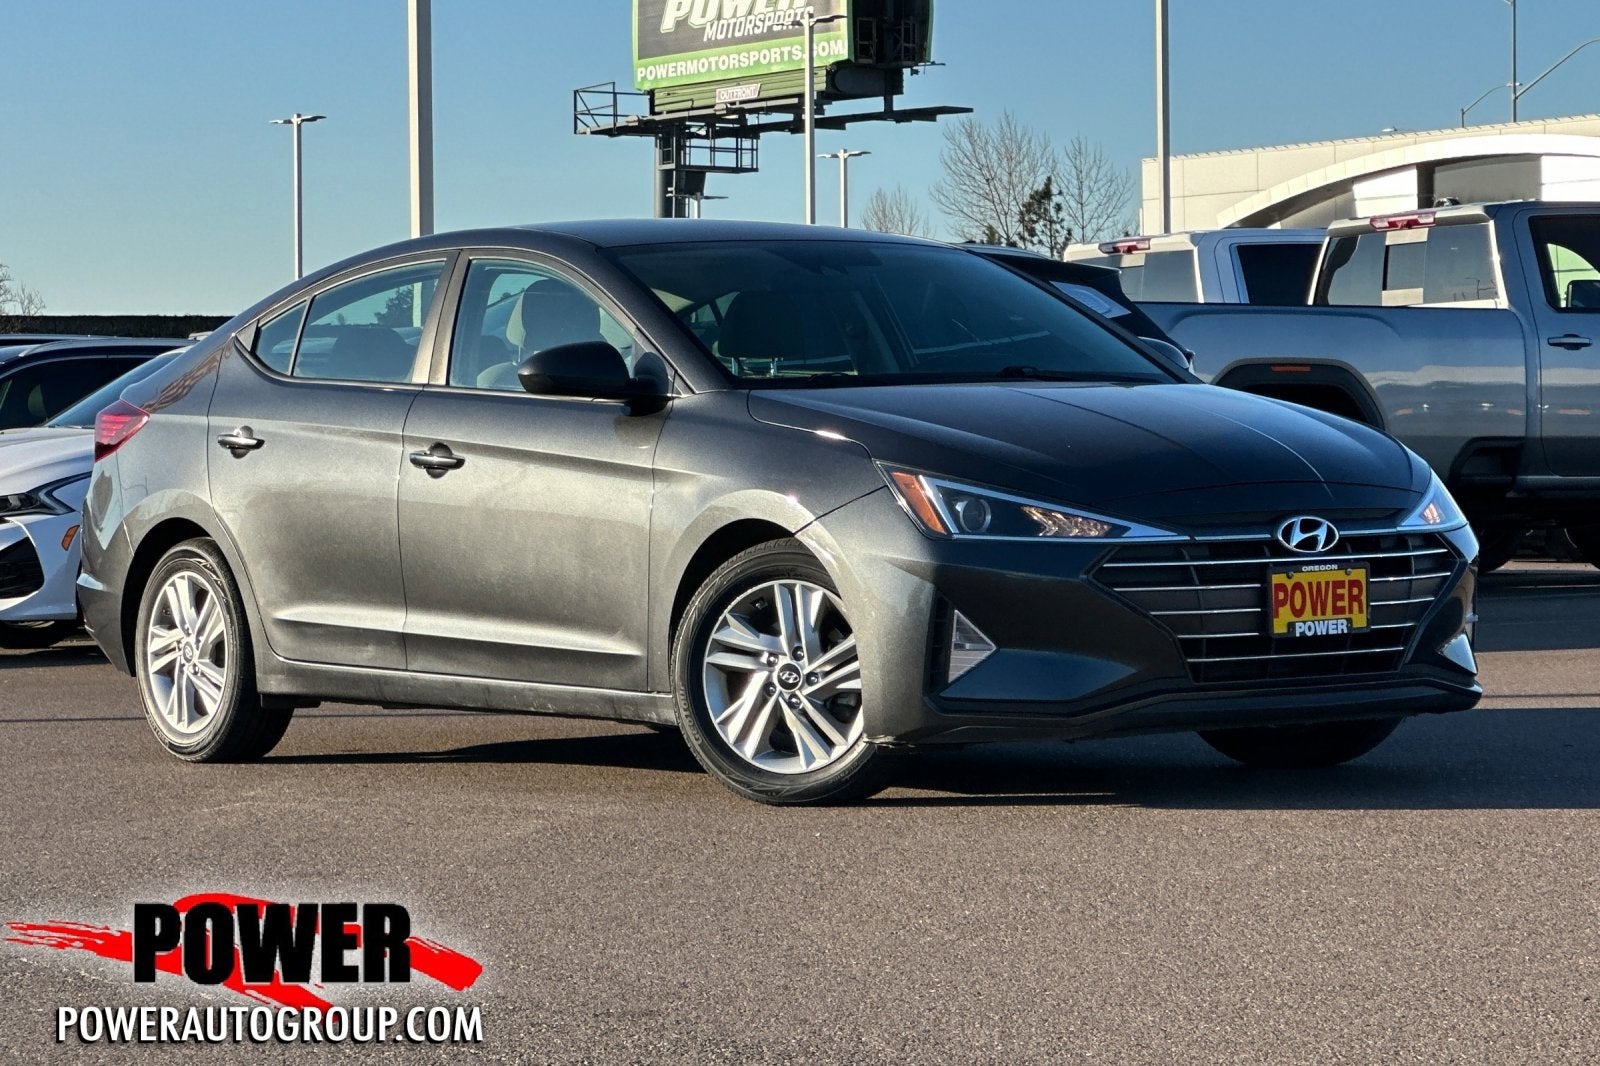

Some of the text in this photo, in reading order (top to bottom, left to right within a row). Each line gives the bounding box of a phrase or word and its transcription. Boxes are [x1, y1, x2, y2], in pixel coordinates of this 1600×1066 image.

[637, 39, 843, 81] POWERMOTORSPORTS.OM
[720, 86, 756, 100] OUTFRONT
[1301, 564, 1338, 572] OREGON
[1273, 579, 1364, 619] POWER
[1295, 619, 1348, 637] POWER
